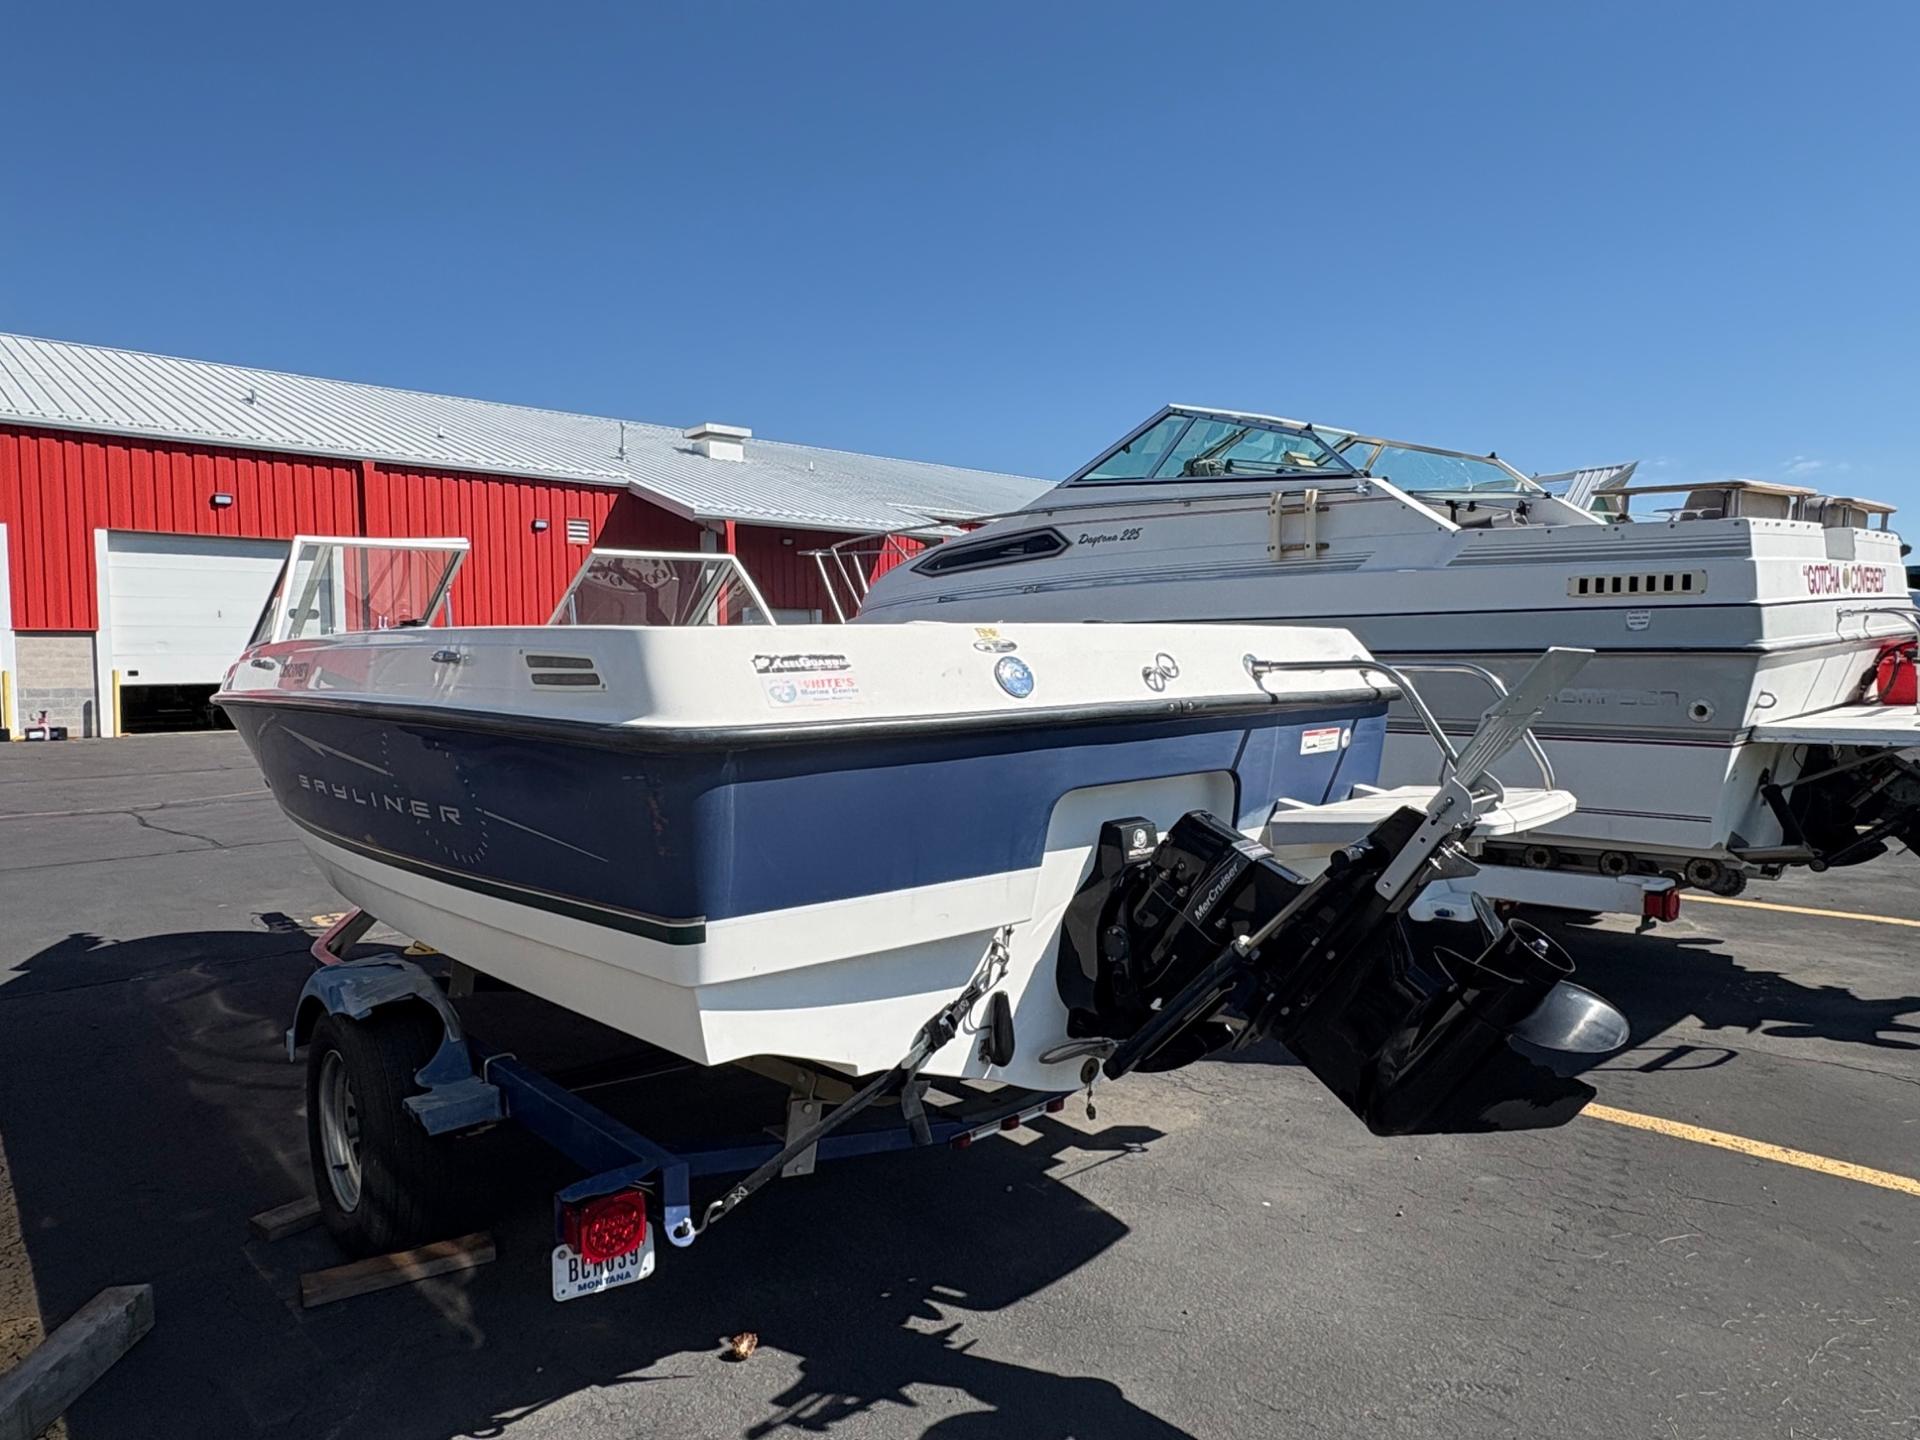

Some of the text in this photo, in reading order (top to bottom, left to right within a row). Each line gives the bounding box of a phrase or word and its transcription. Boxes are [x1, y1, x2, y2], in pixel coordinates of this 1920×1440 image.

[1078, 527, 1143, 547] Daytona 225
[298, 774, 463, 826] BAYLINER
[1193, 862, 1239, 921] MerCruiser
[577, 1270, 632, 1292] MONTANA
